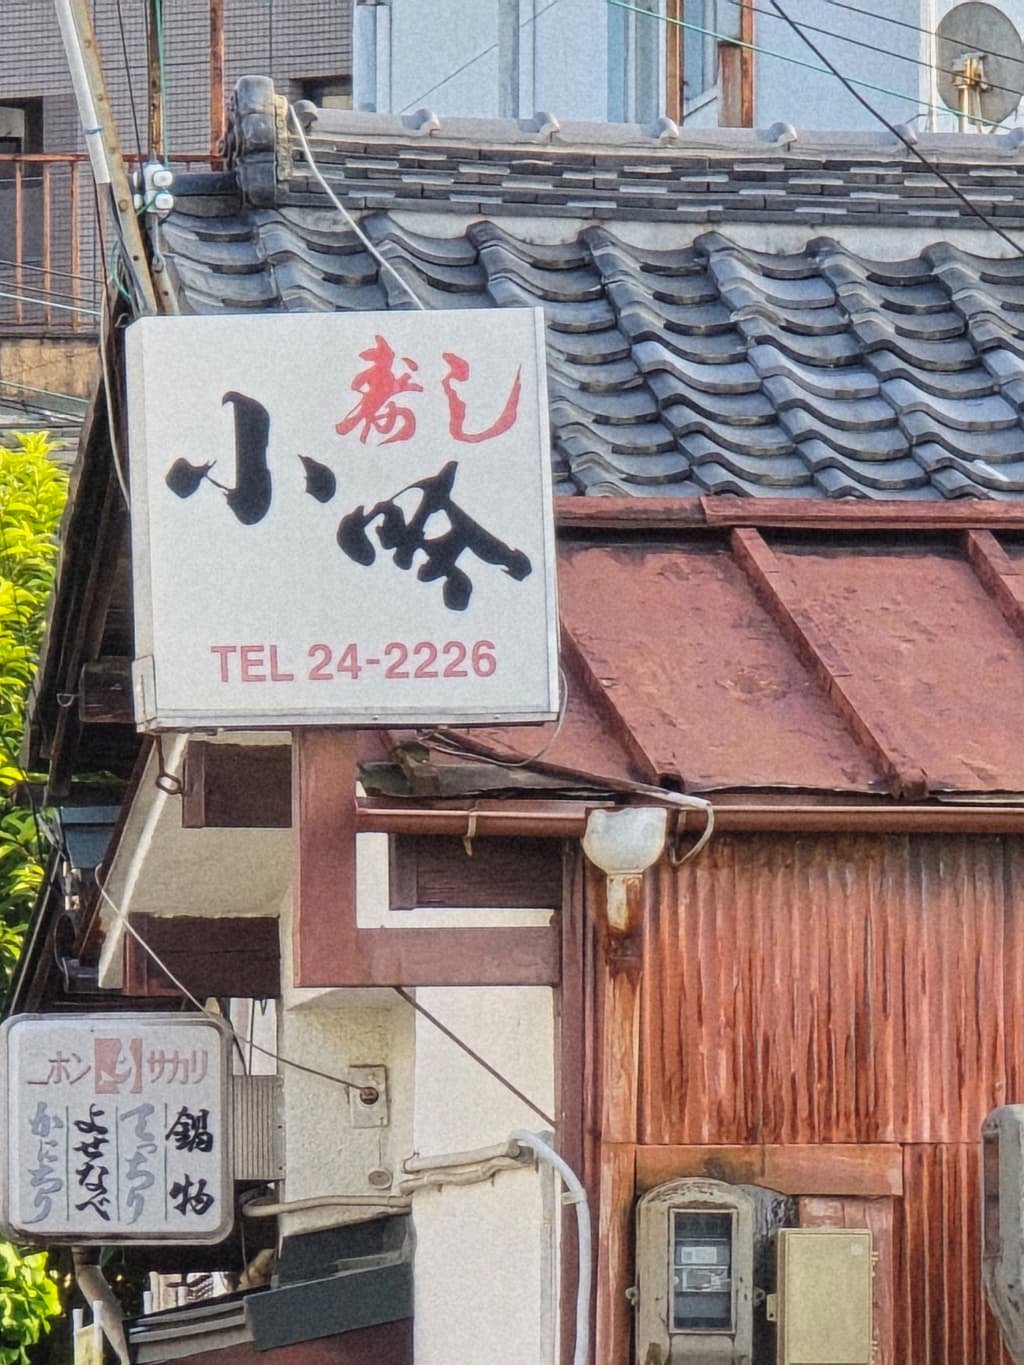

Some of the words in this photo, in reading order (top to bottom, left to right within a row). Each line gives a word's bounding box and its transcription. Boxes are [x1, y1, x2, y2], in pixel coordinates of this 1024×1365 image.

[211, 643, 294, 683] TEL
[307, 639, 498, 681] 24-2226
[147, 1049, 209, 1086] サカリ
[22, 1101, 64, 1224] かにちり
[73, 1103, 111, 1221] よせなべ
[119, 1102, 158, 1225] てっちり
[165, 1105, 215, 1216] 鍋物
